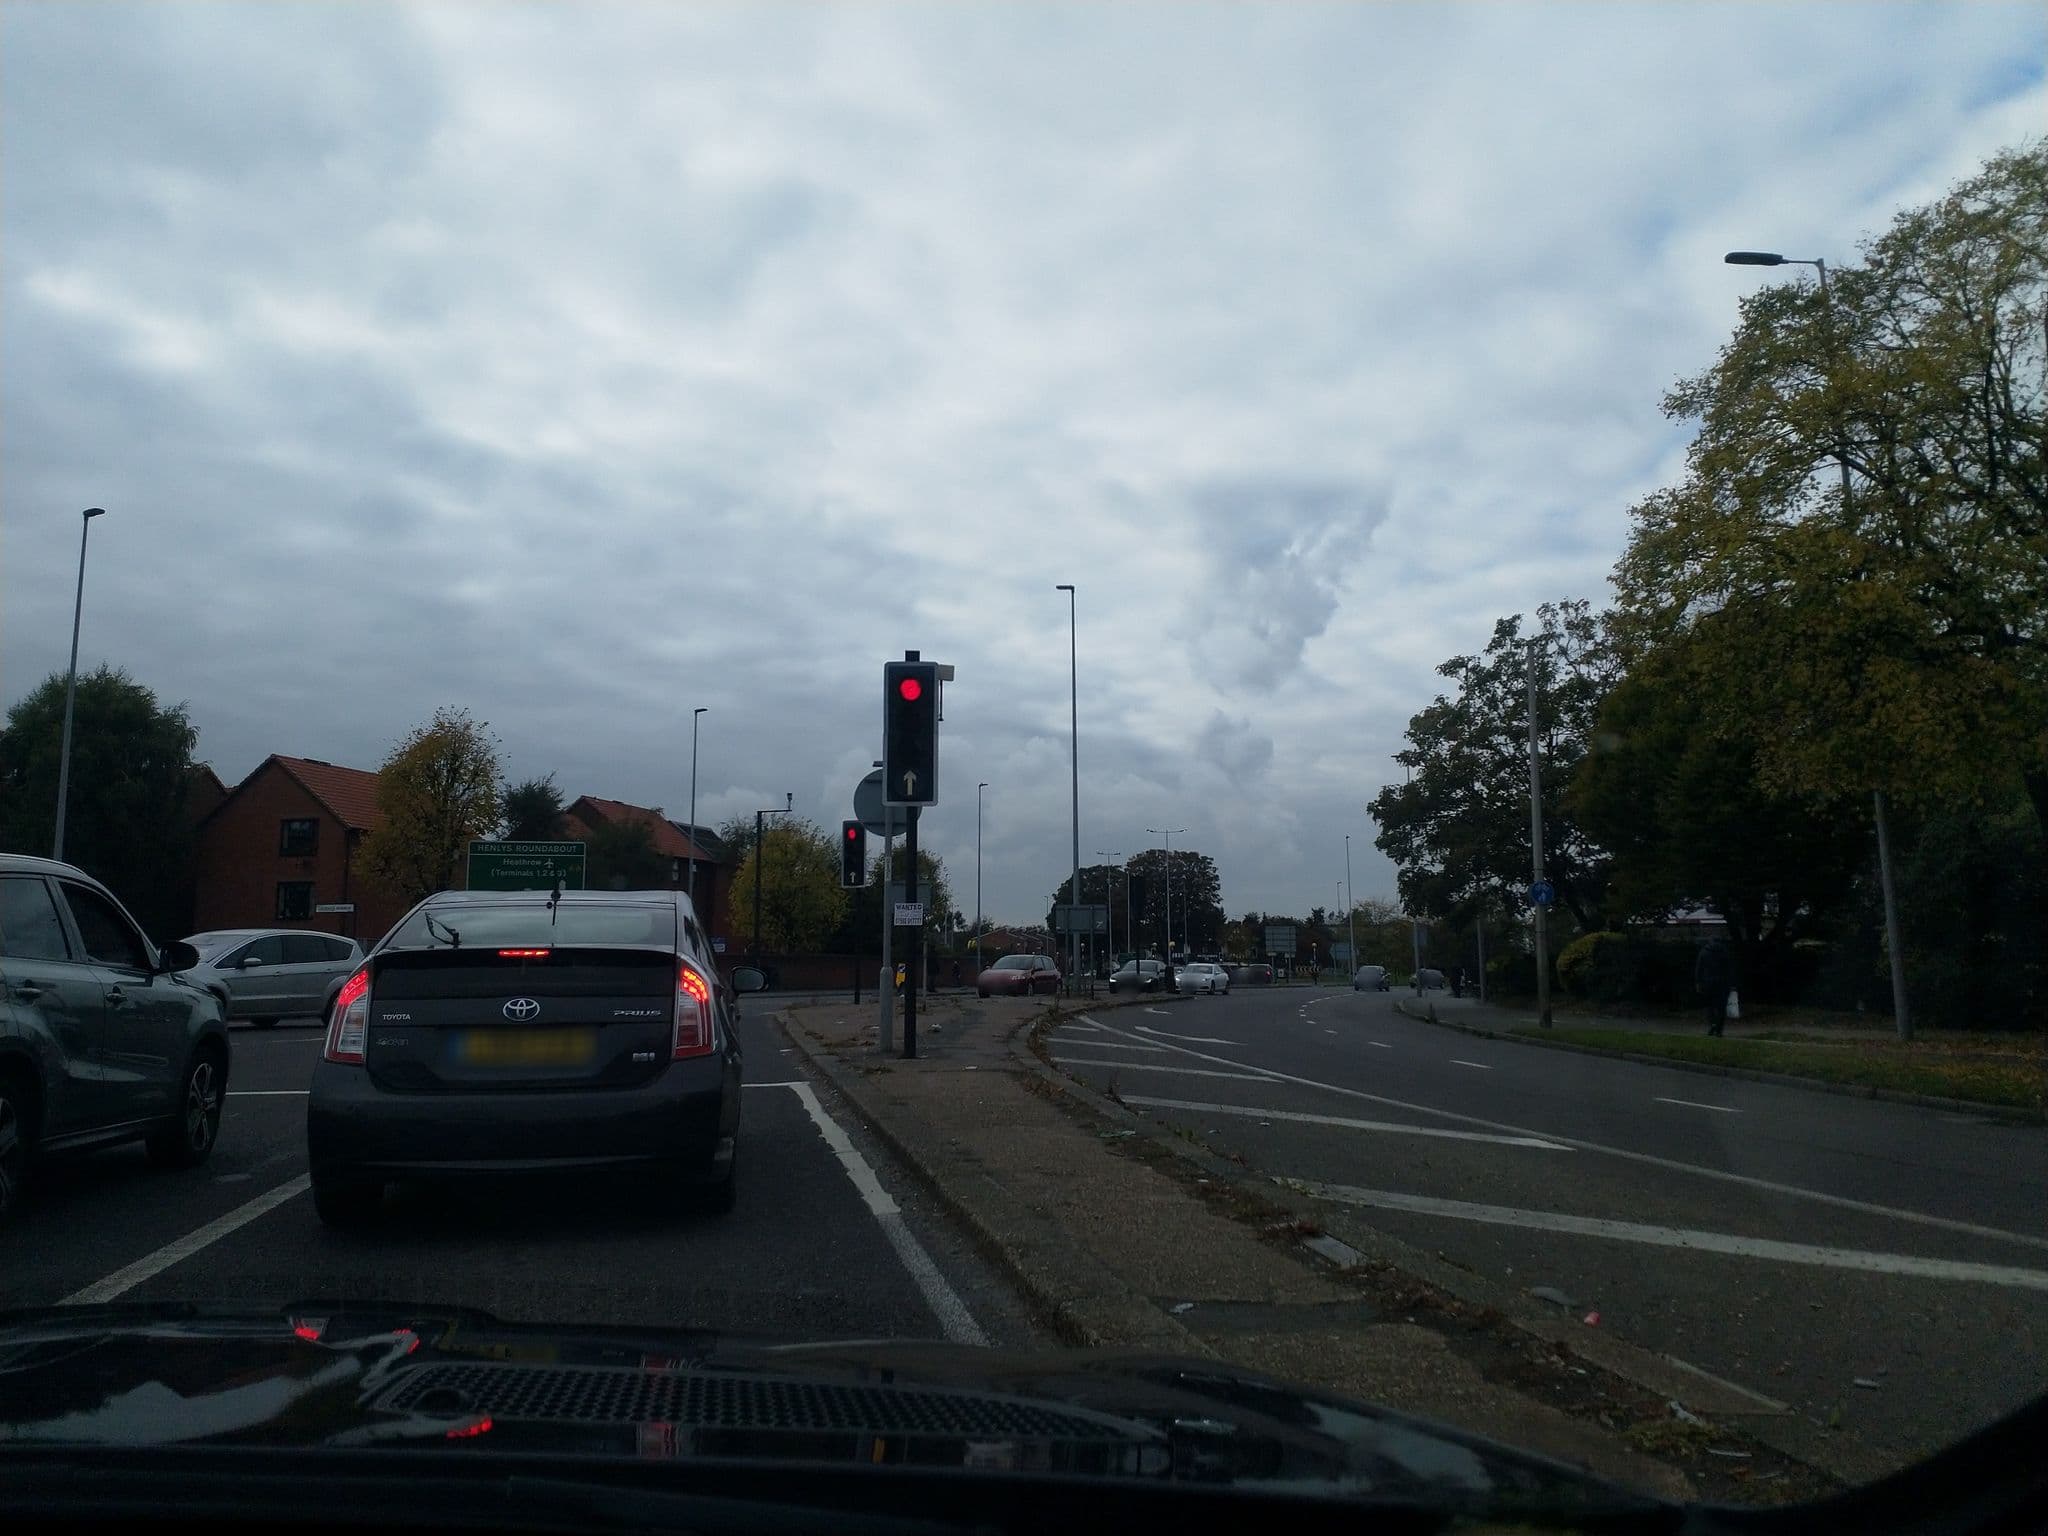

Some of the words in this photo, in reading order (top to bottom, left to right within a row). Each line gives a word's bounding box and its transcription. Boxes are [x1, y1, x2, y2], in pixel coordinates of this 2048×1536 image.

[478, 844, 513, 852] HENLYS
[516, 844, 577, 853] ROUNDABOUT
[503, 858, 542, 866] Heathrow
[382, 1013, 412, 1021] TOYOTA
